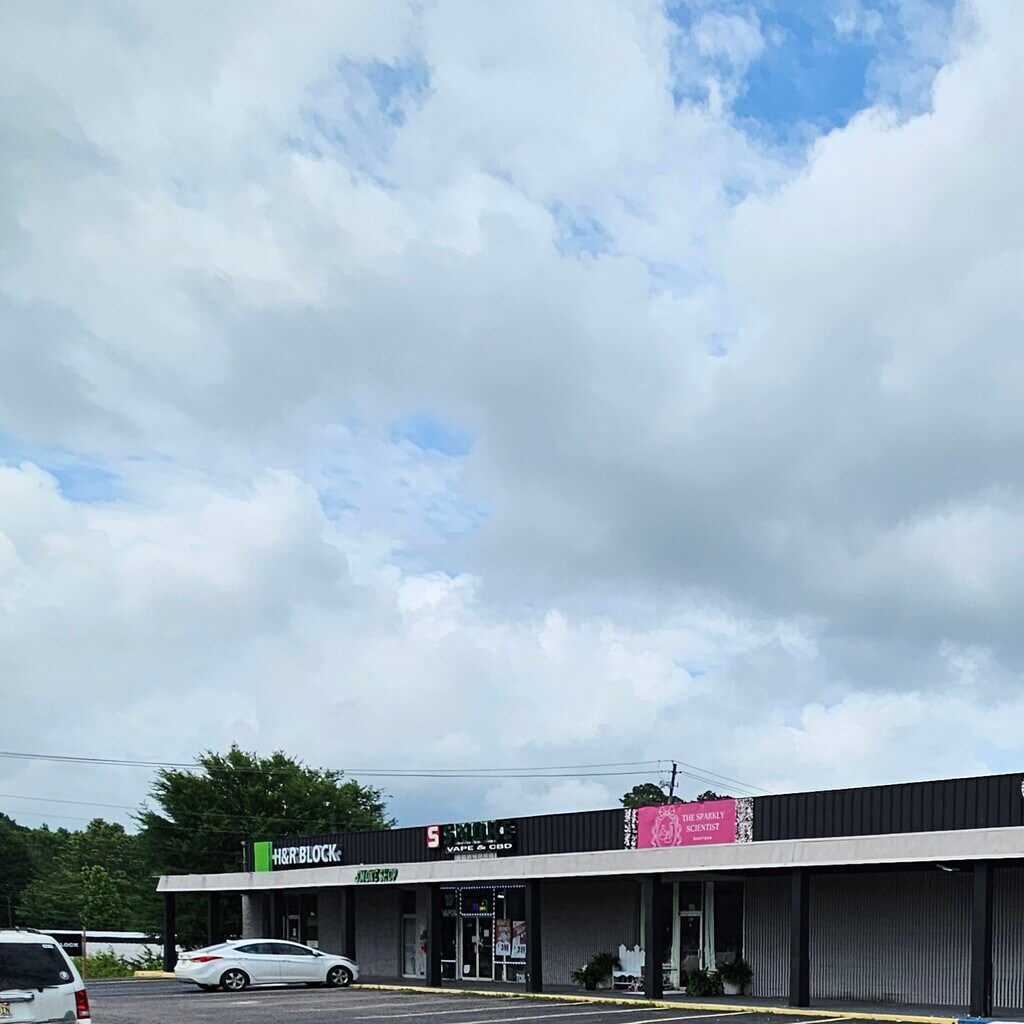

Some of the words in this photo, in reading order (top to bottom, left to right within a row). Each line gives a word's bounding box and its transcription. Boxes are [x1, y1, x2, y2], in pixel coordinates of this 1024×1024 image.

[682, 814, 695, 822] THE
[696, 811, 725, 820] SPARKLY
[686, 823, 719, 832] SCIENTIST
[443, 821, 515, 846] SMOKE
[272, 847, 298, 866] H&R
[299, 843, 338, 864] BLOCK
[447, 845, 474, 853] VAPE
